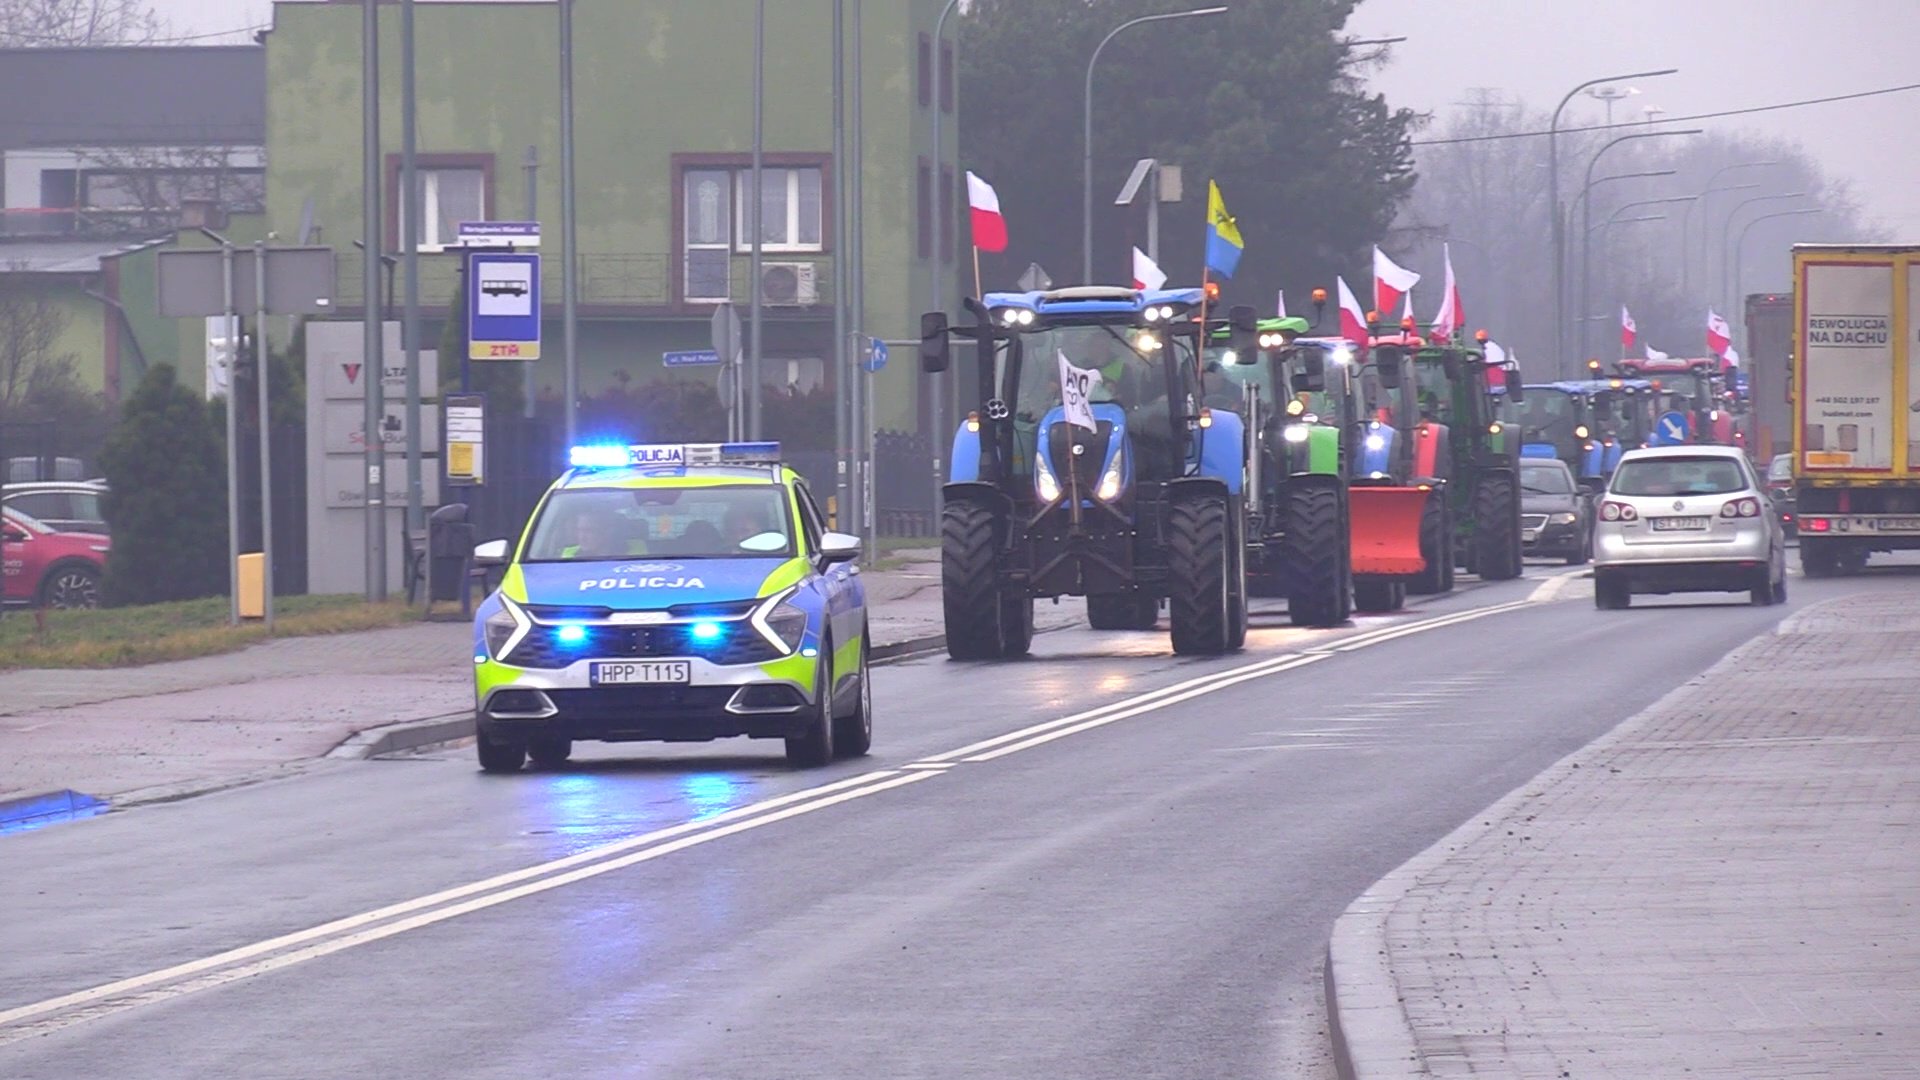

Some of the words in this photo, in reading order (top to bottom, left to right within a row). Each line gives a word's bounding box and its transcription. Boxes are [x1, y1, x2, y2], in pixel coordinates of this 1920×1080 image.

[1809, 319, 1887, 329] REWOLUCJA
[1809, 331, 1831, 343] NA
[1834, 332, 1888, 344] DACHU
[630, 449, 682, 461] POLICJA
[579, 577, 705, 591] POLICJA
[602, 665, 635, 681] HPP
[641, 664, 684, 681] T115
